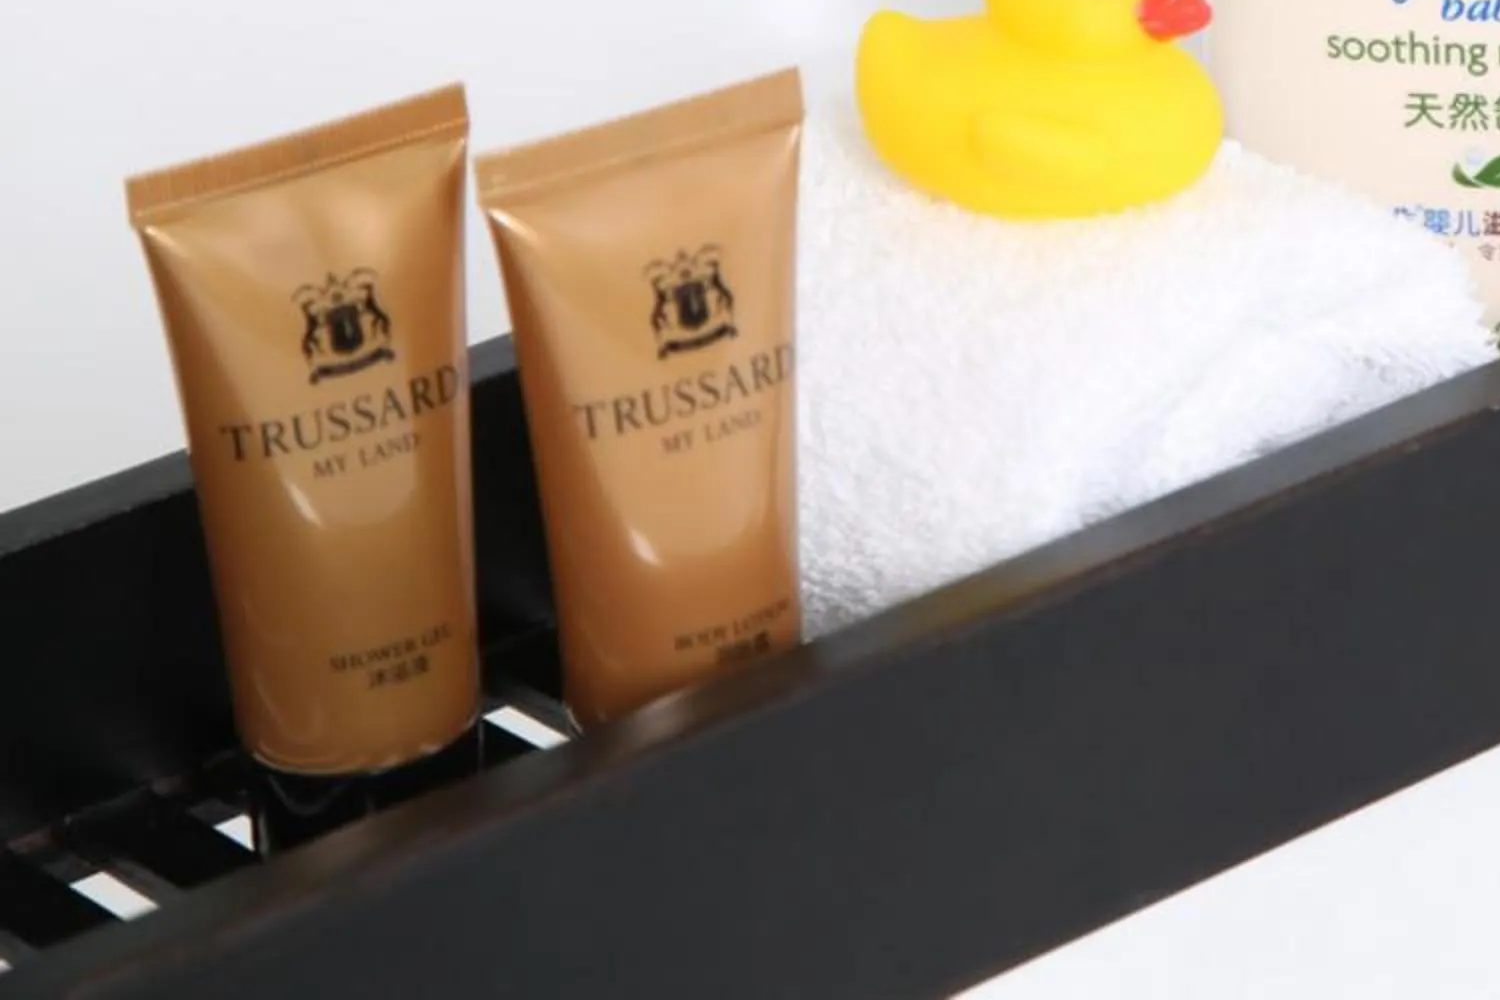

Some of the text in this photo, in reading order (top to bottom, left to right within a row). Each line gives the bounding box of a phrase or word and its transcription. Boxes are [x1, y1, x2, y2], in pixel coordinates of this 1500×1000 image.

[1326, 30, 1489, 78] soothing
[218, 364, 460, 463] TRUSSARD
[660, 408, 762, 454] MY LAND
[312, 432, 423, 479] MY LAND
